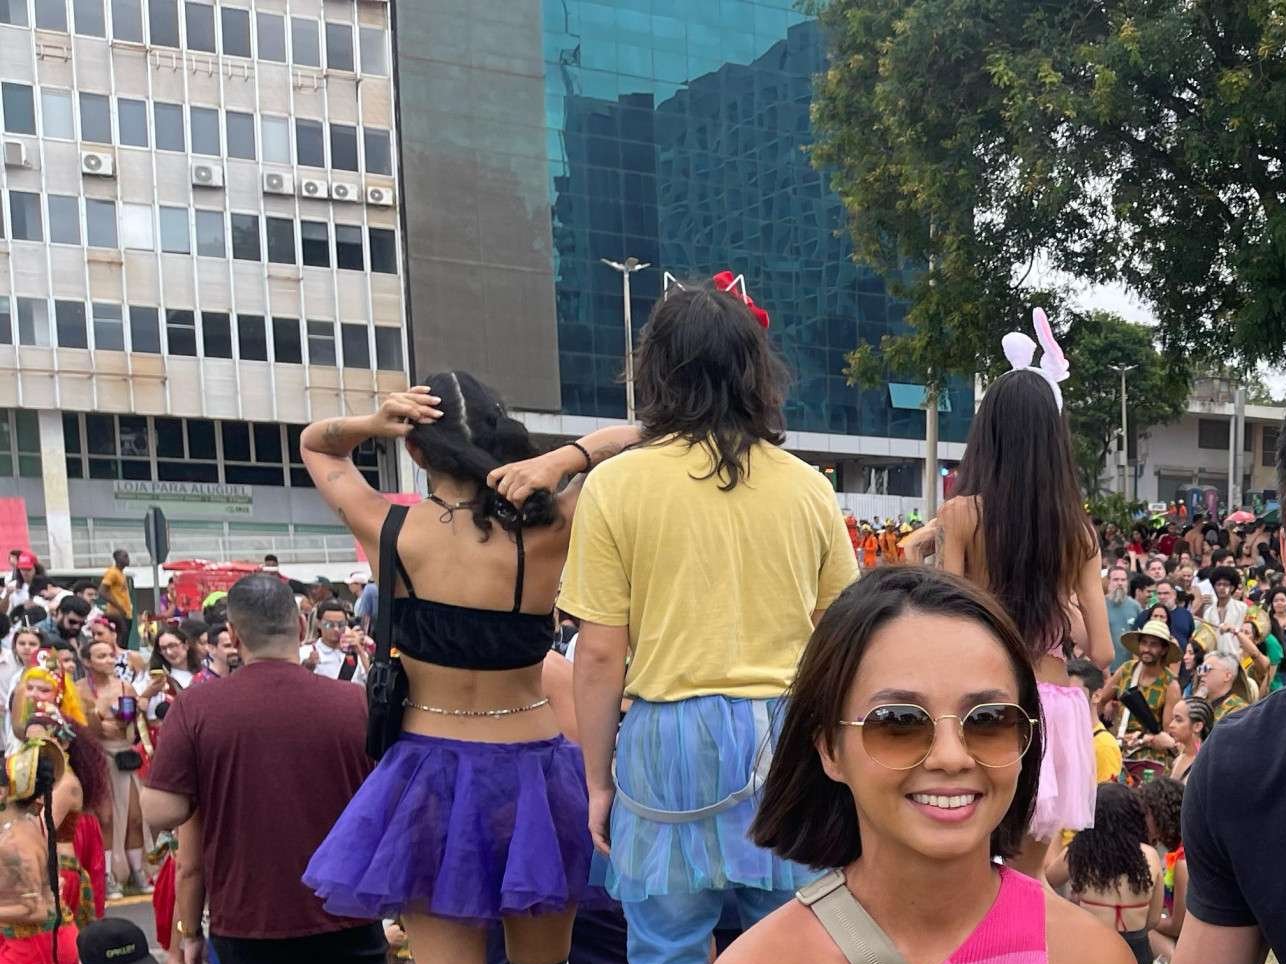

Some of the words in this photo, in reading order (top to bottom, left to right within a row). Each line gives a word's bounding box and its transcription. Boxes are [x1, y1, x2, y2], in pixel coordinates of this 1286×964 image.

[117, 481, 148, 493] LOJA
[152, 481, 187, 494] PARA
[191, 483, 246, 496] ALUGUEL
